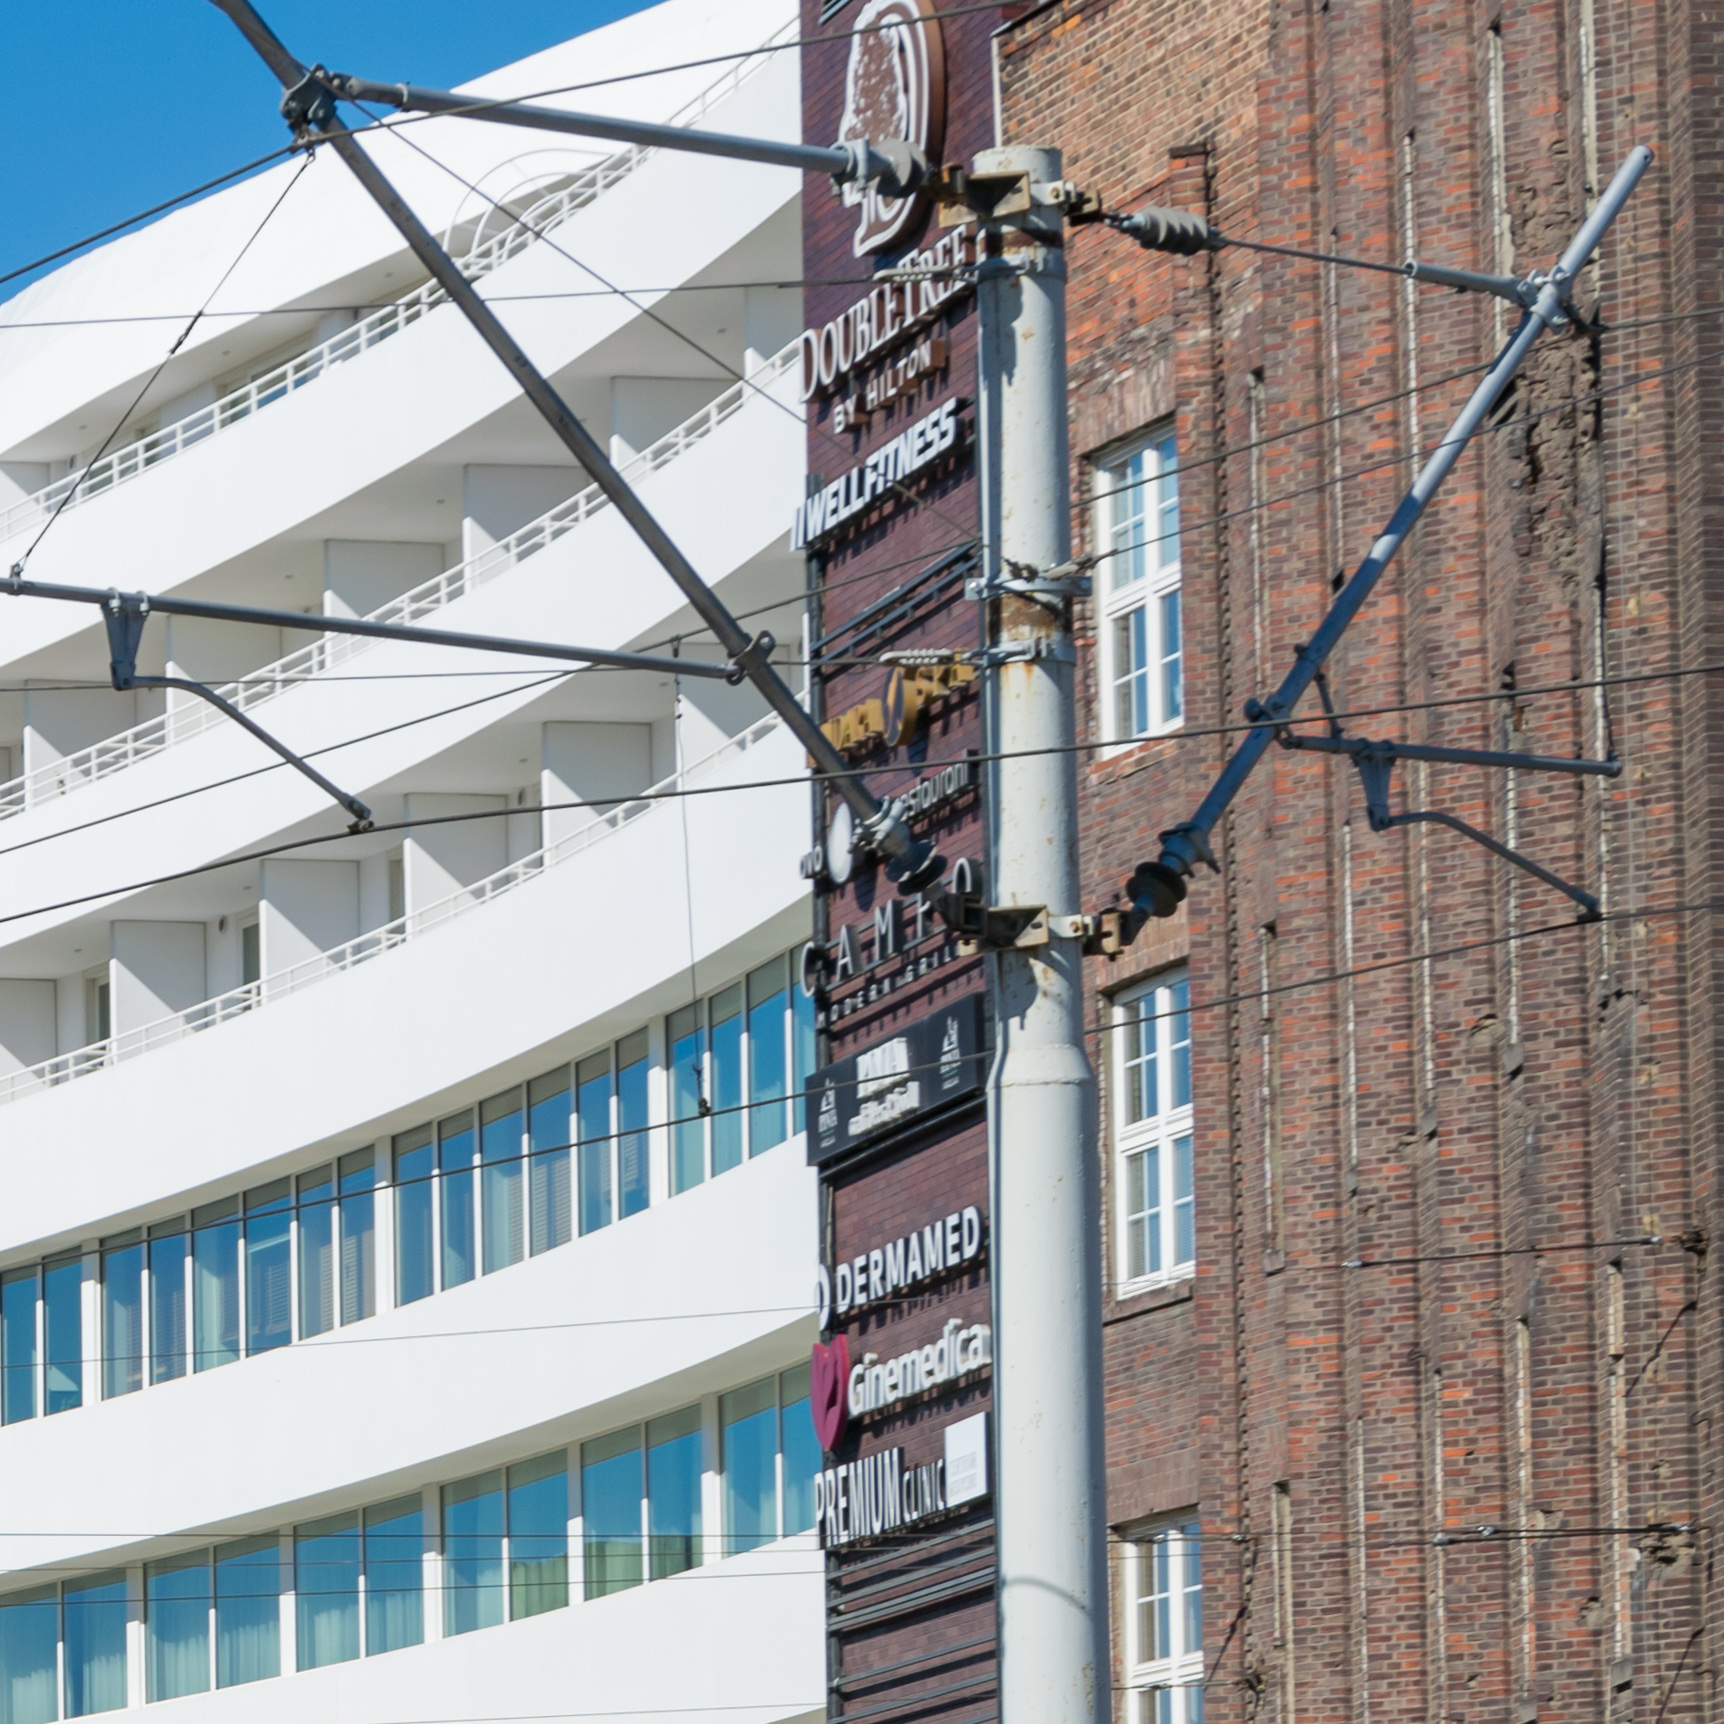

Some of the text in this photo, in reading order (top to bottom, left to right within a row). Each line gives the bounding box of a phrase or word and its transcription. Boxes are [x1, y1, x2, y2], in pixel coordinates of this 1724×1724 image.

[832, 340, 933, 434] BY HILTON
[816, 943, 960, 1029] MODERN GRIL
[836, 1205, 982, 1315] DERMAMED
[848, 1318, 992, 1417] Ginemedica
[815, 1446, 901, 1549] PREMIUM
[902, 1458, 946, 1522] CLINIC
